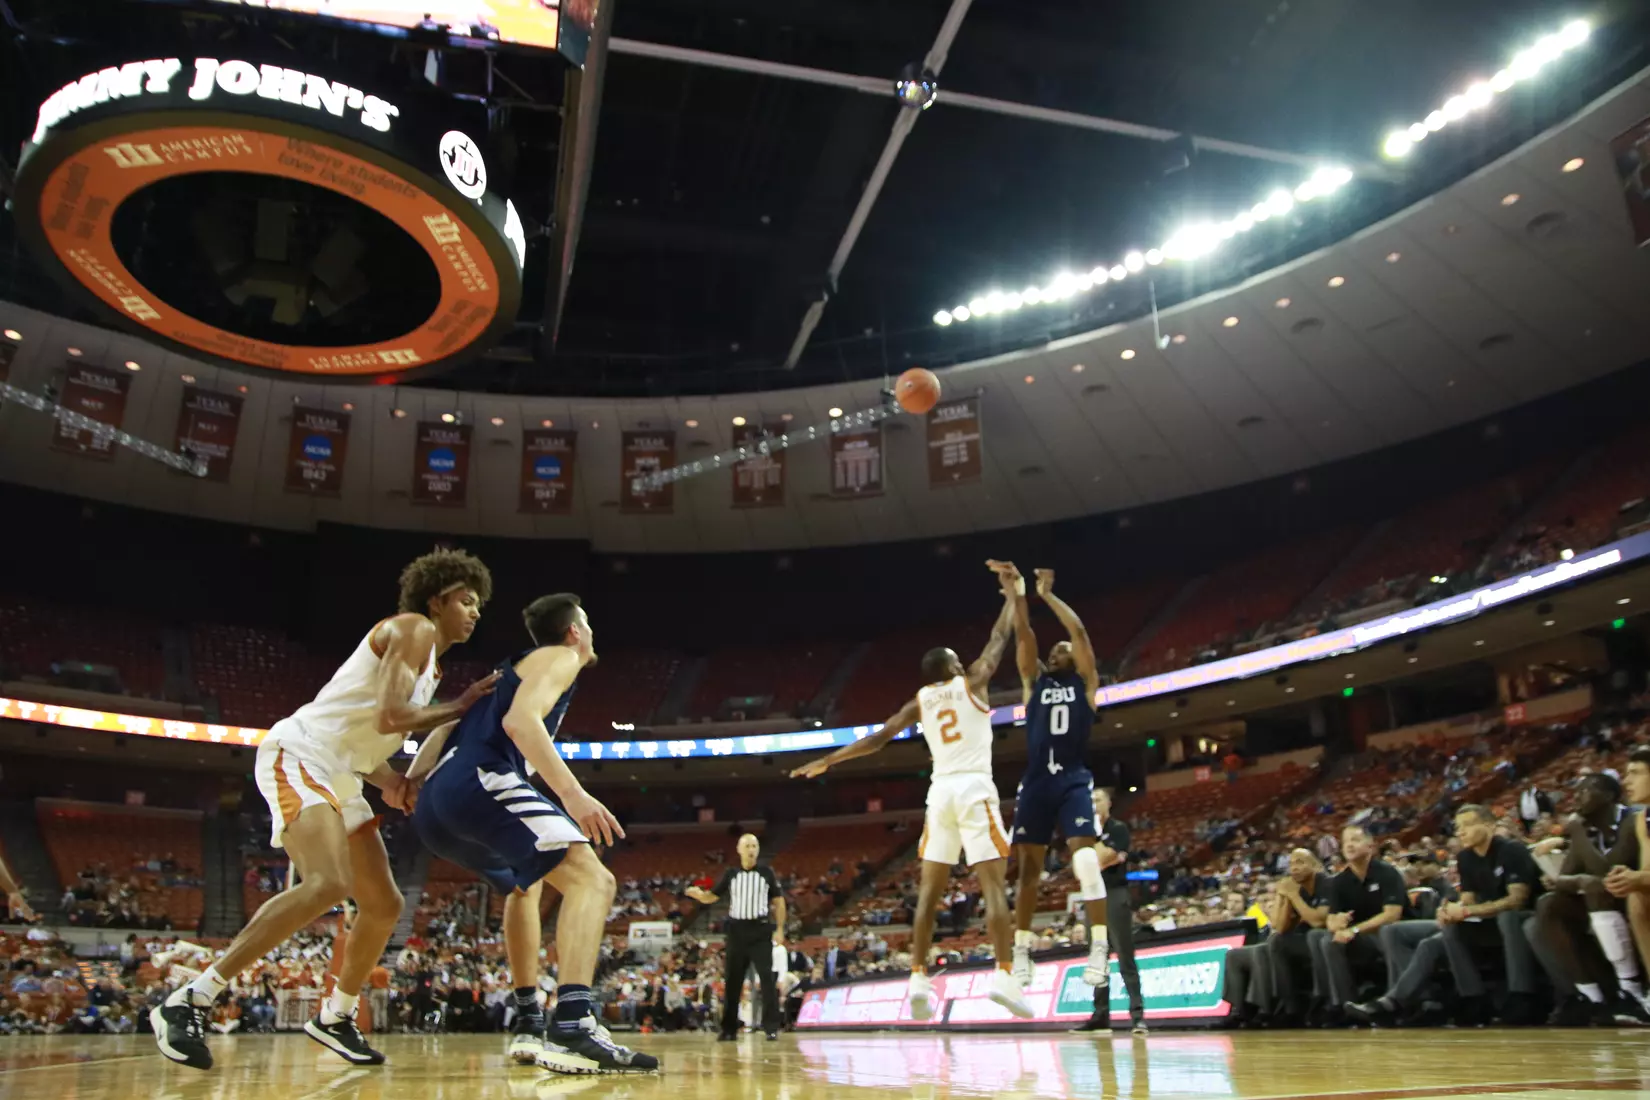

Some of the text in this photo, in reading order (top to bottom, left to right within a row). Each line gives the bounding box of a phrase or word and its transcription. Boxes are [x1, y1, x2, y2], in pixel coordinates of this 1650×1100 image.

[188, 57, 400, 132] JOHN'S
[159, 134, 246, 155] AMERICAN
[165, 144, 253, 164] CAMPUS
[1040, 686, 1076, 705] CBU
[936, 708, 962, 745] 2
[1049, 704, 1070, 736] 0
